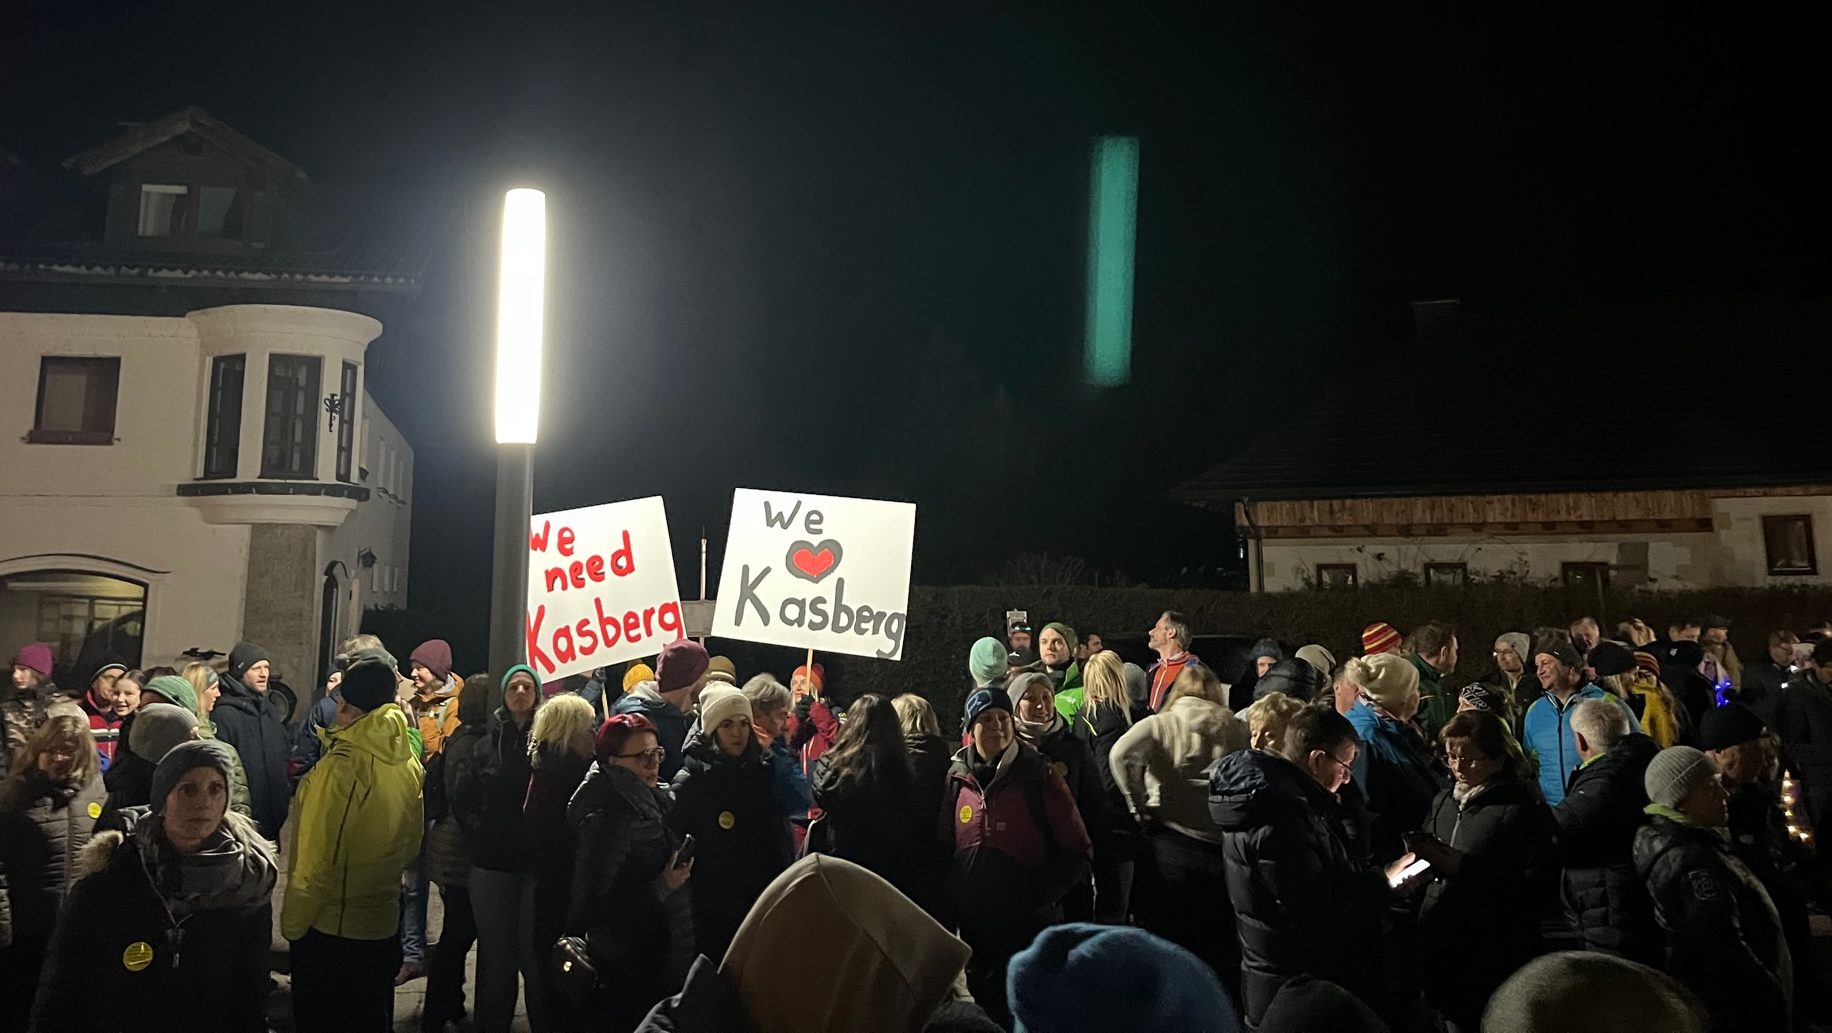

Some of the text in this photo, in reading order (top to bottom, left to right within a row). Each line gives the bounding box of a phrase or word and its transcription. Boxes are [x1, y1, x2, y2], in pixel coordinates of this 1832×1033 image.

[763, 499, 824, 535] We
[544, 530, 636, 592] need
[526, 597, 684, 674] Kasberg
[733, 563, 907, 660] Kasberg
